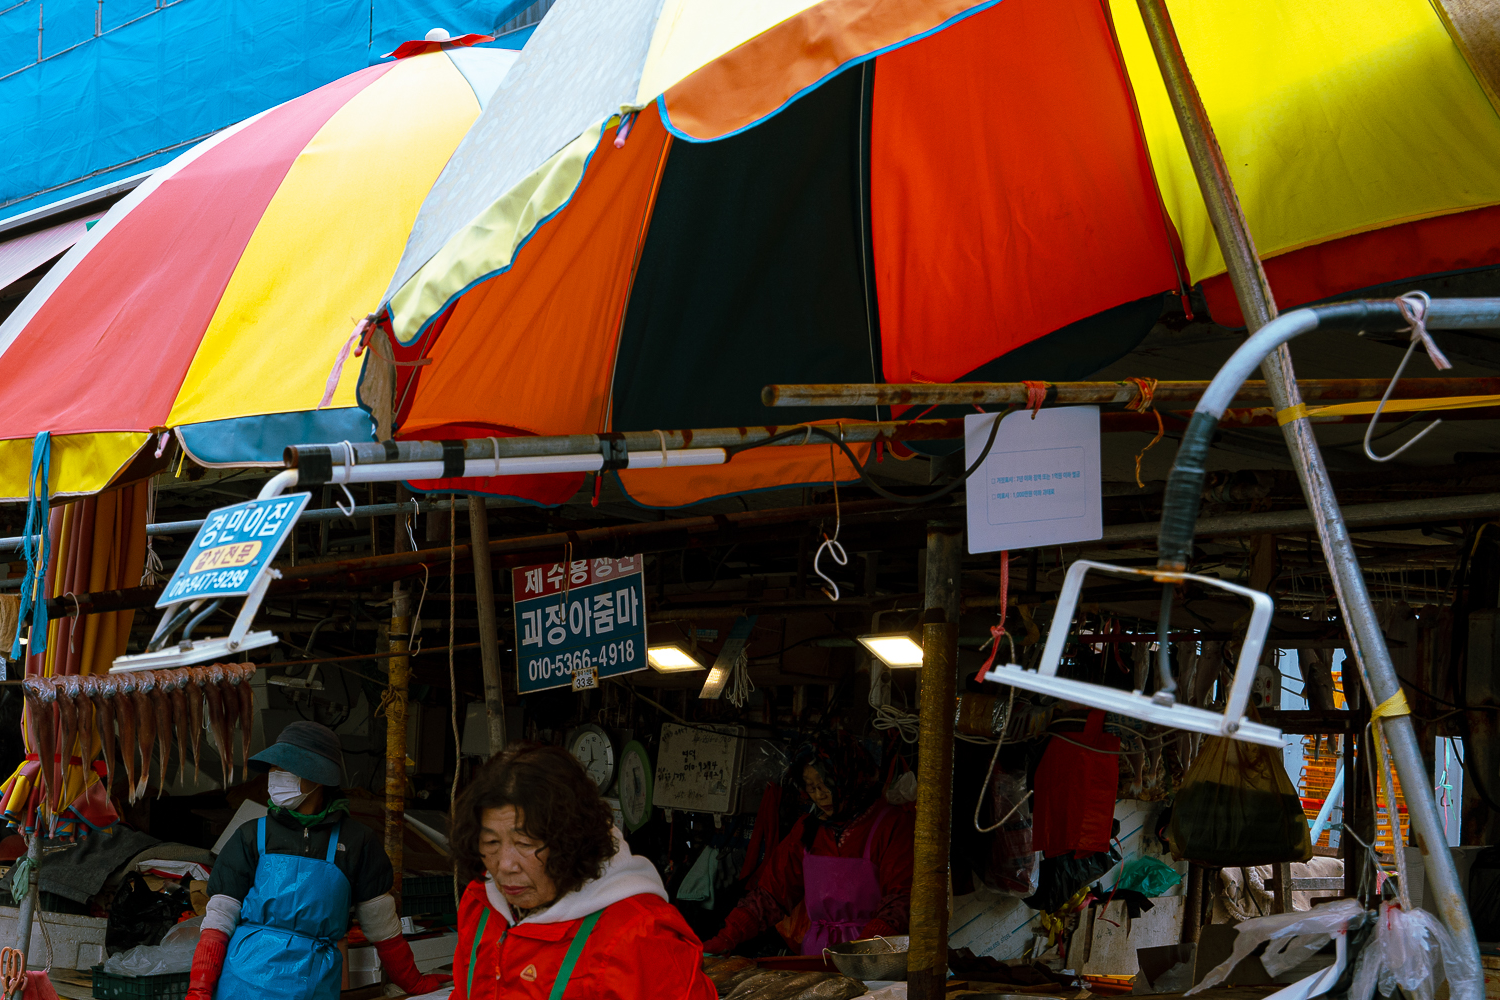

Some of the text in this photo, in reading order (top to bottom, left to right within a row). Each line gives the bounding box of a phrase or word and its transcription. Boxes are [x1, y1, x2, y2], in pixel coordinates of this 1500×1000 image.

[199, 501, 294, 547] 경민이집
[194, 544, 255, 571] 갈치전문
[168, 569, 249, 598] 010-9477-9299
[525, 559, 589, 594] 제수용
[522, 586, 639, 647] 괴정아줌마
[528, 640, 635, 681] 010-5366-4918
[576, 677, 595, 689] 33호
